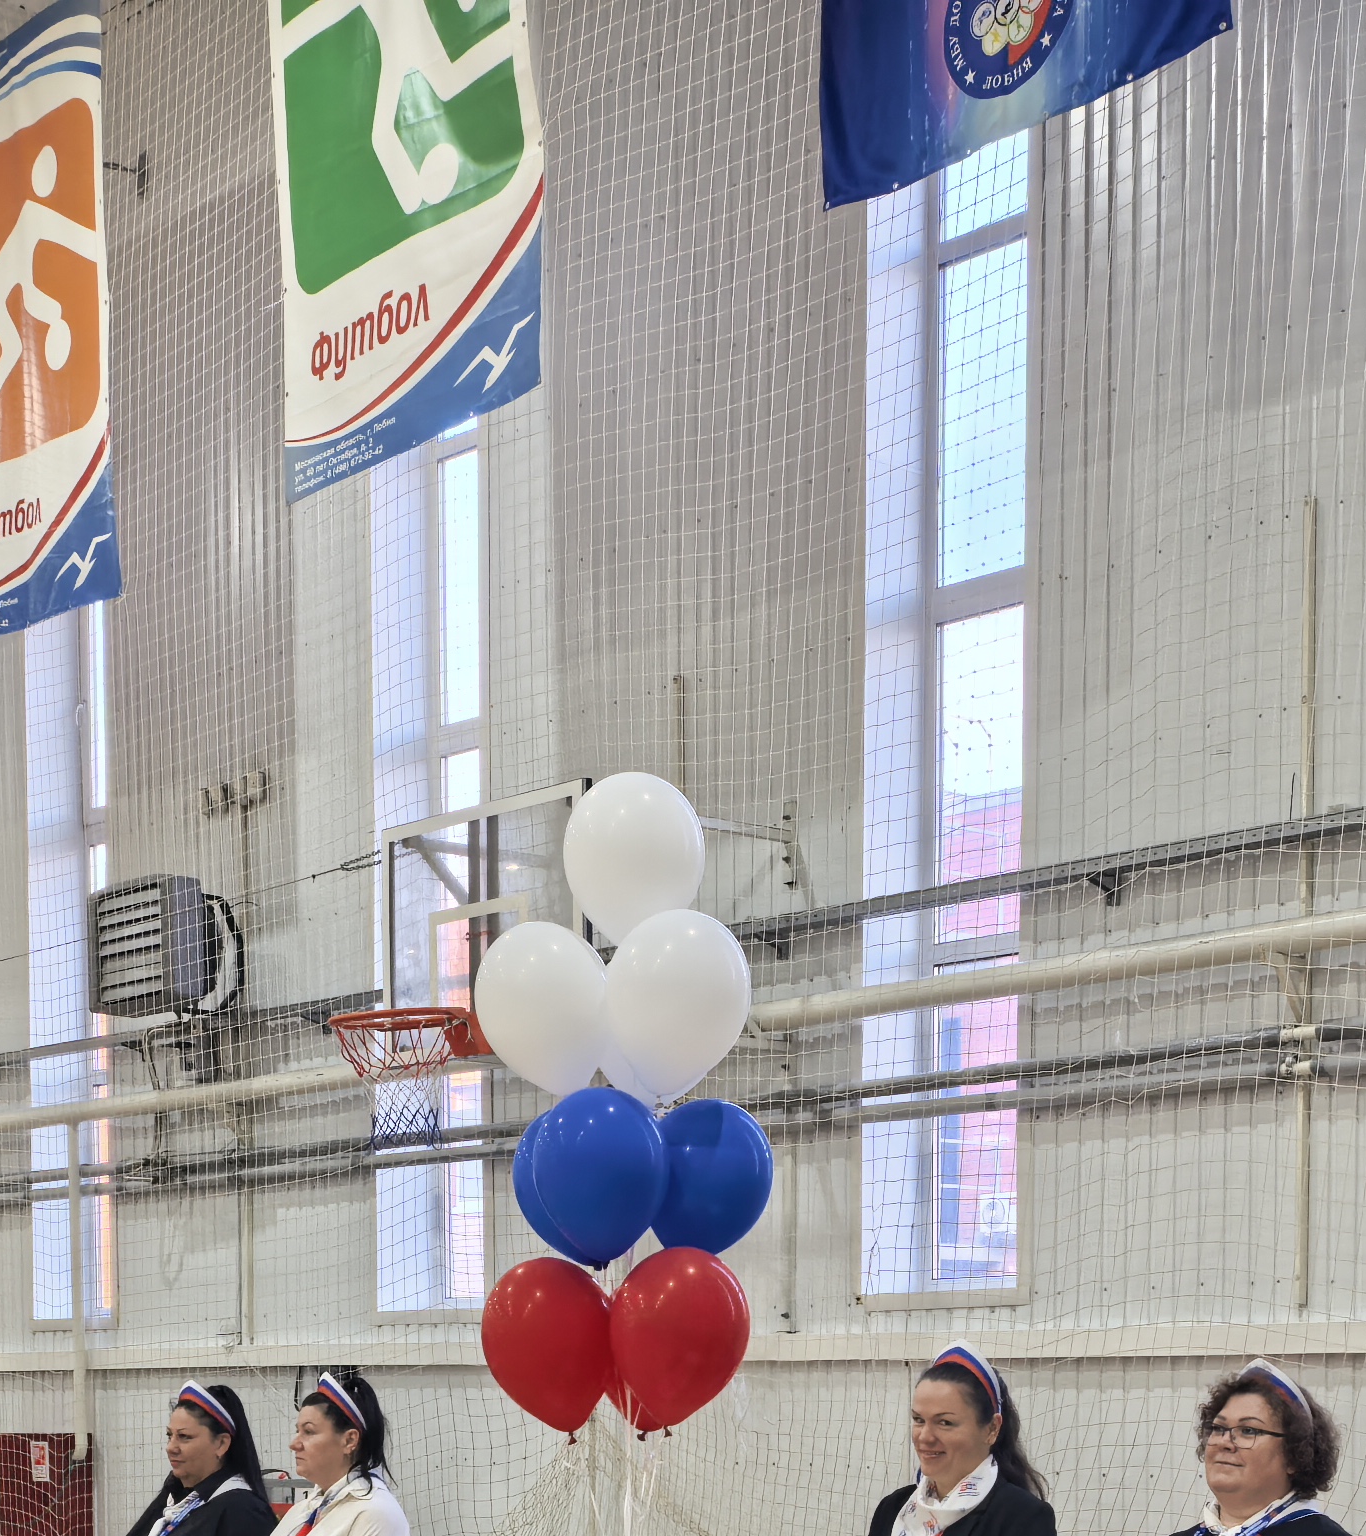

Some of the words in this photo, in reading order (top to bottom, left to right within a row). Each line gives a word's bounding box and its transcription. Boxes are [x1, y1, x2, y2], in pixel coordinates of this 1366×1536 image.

[949, 36, 966, 72] МБУ
[982, 56, 1033, 90] ЛОБНЯ
[311, 283, 430, 381] Футбол
